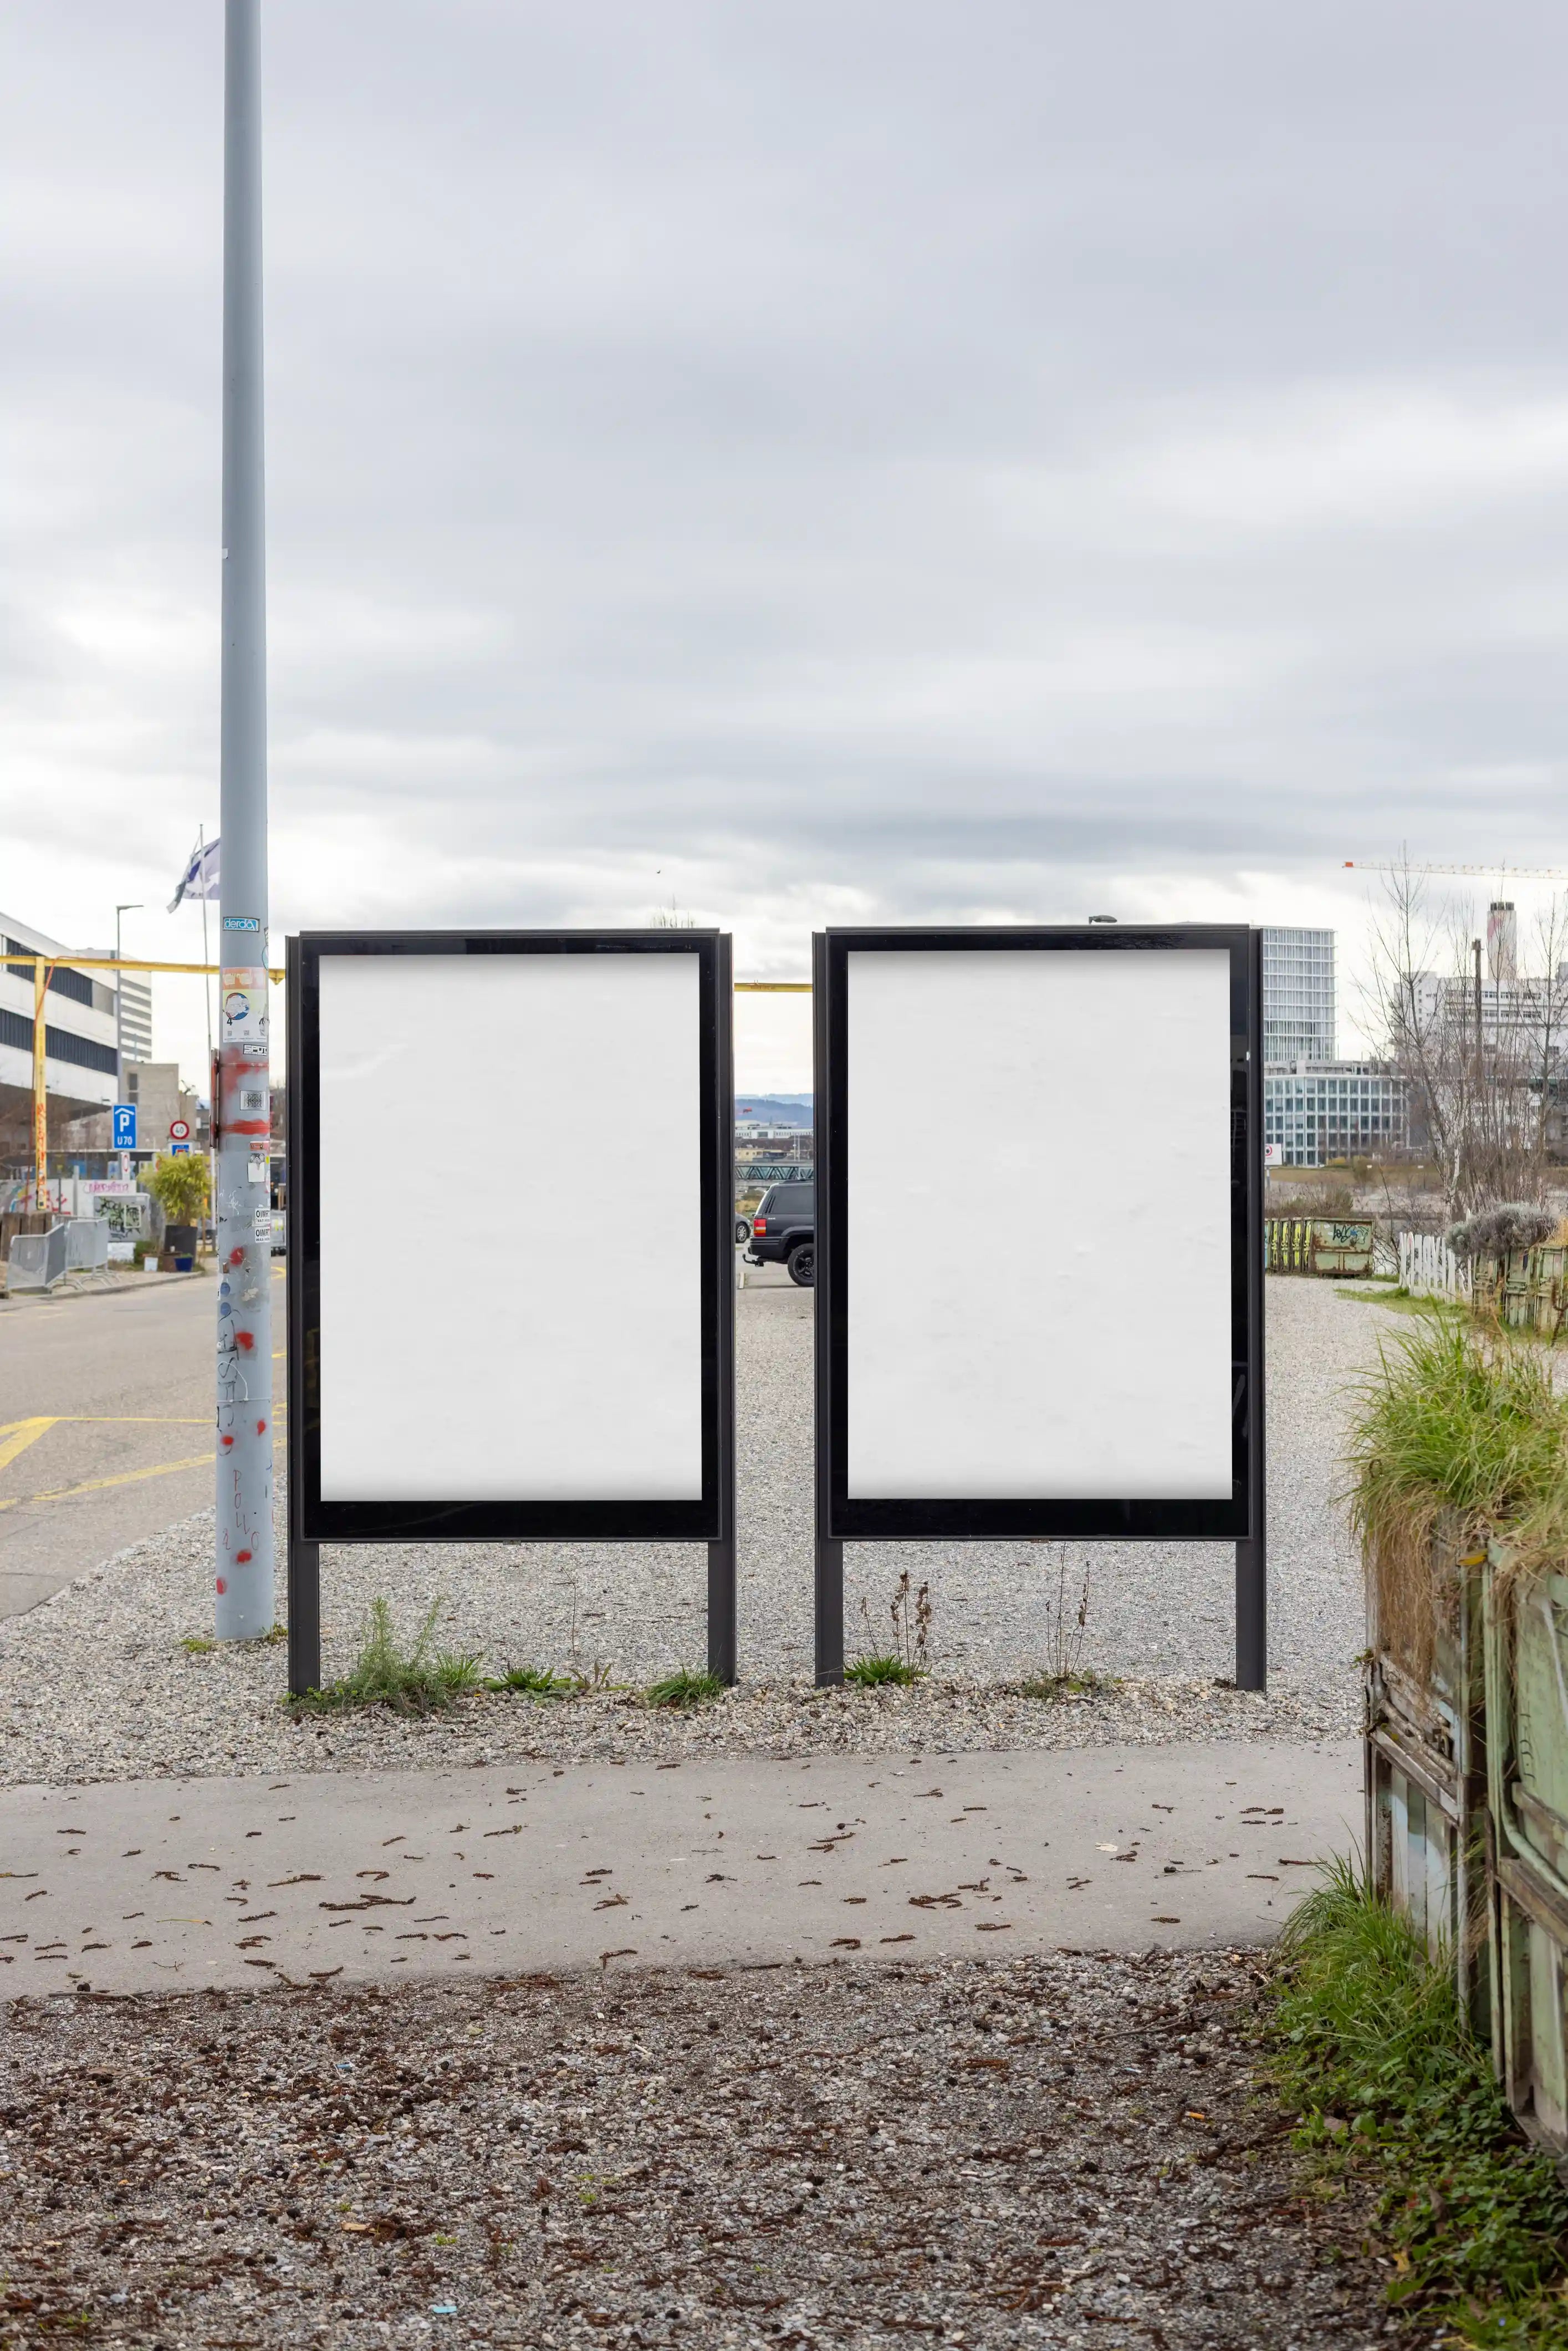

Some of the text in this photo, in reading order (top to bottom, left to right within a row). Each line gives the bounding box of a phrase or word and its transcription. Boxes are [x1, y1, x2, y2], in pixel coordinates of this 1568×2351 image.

[120, 1114, 130, 1132] P
[117, 1135, 133, 1145] U 70
